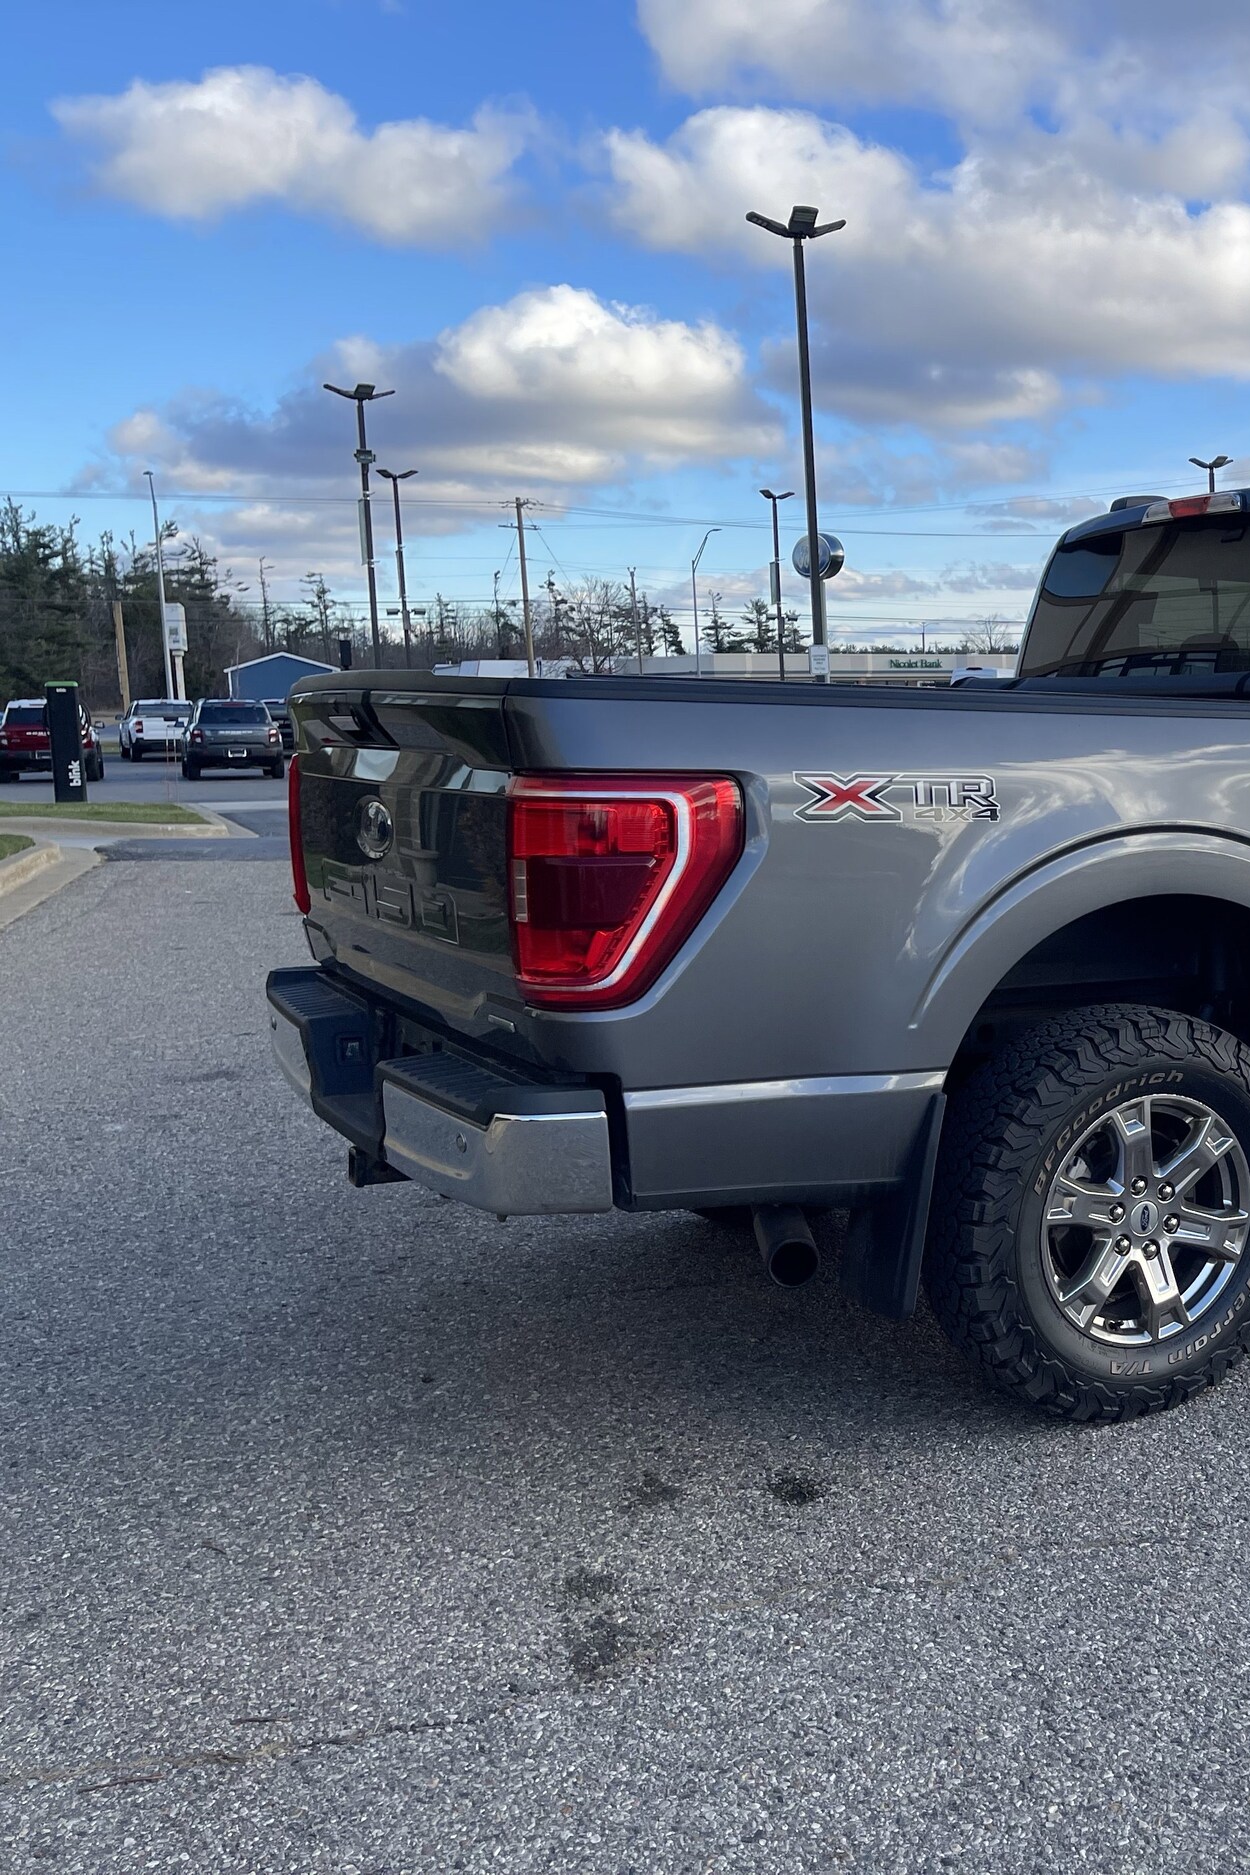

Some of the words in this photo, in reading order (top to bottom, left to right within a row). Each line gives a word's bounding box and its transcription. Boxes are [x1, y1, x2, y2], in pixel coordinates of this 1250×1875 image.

[889, 658, 918, 669] Nicolet
[920, 658, 943, 669] Bank
[68, 759, 82, 787] blink
[1034, 1070, 1184, 1196] BFGoodrich
[1110, 1359, 1154, 1376] T/A
